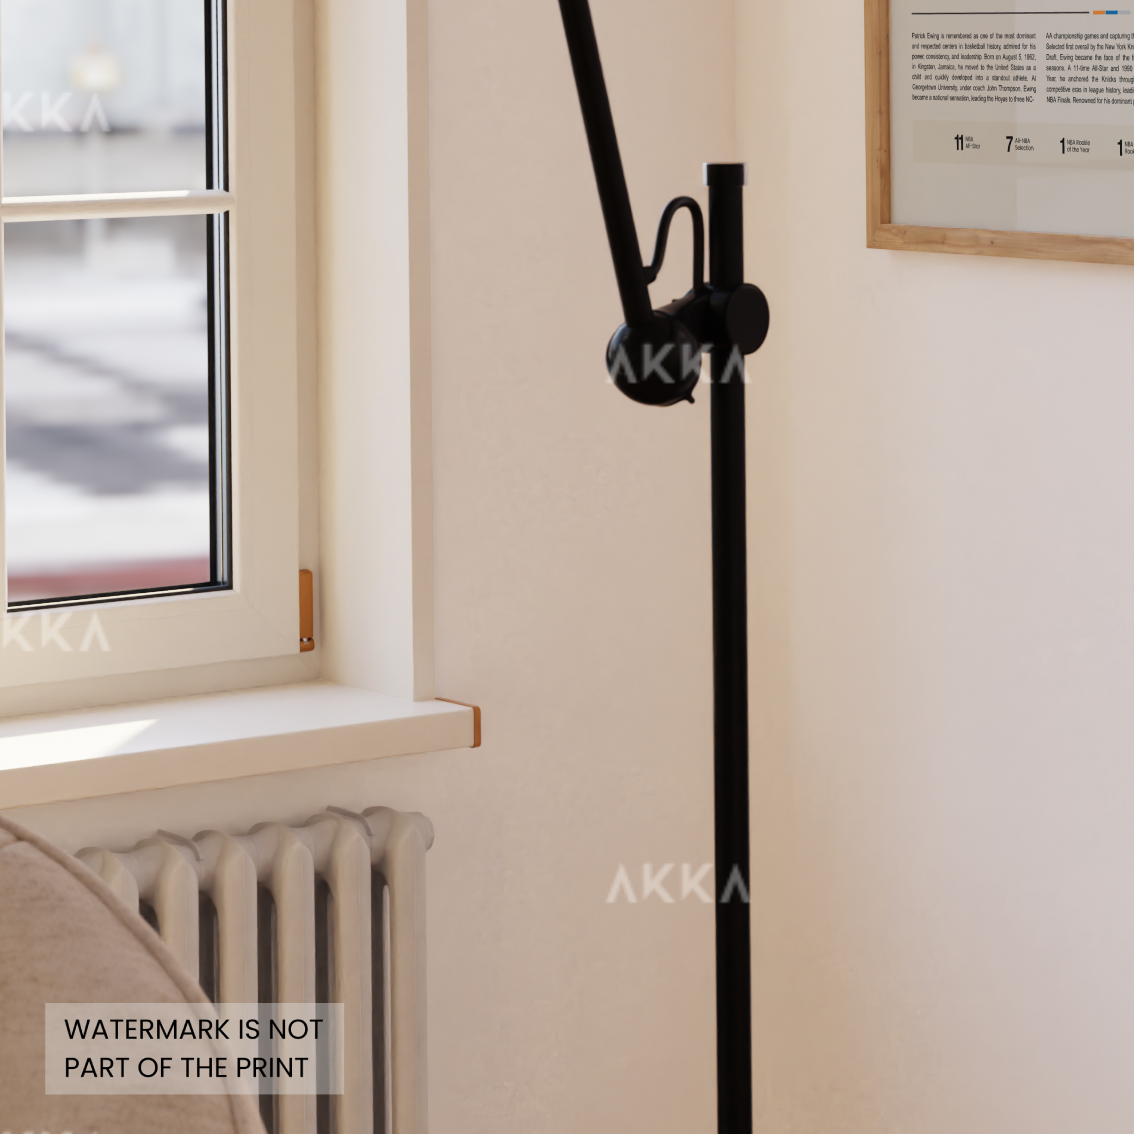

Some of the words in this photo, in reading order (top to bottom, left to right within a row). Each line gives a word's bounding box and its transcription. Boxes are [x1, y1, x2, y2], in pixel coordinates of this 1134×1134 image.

[1045, 31, 1053, 40] AA
[1083, 33, 1100, 42] games
[1099, 31, 1109, 40] and
[1109, 32, 1131, 42] capturing
[1096, 42, 1104, 51] the
[1104, 43, 1116, 51] New
[1115, 43, 1127, 51] York
[1059, 53, 1074, 63] Ewing
[954, 134, 964, 151] 11
[1006, 136, 1014, 152] 7
[1060, 138, 1066, 154] 1
[1117, 140, 1122, 156] 1
